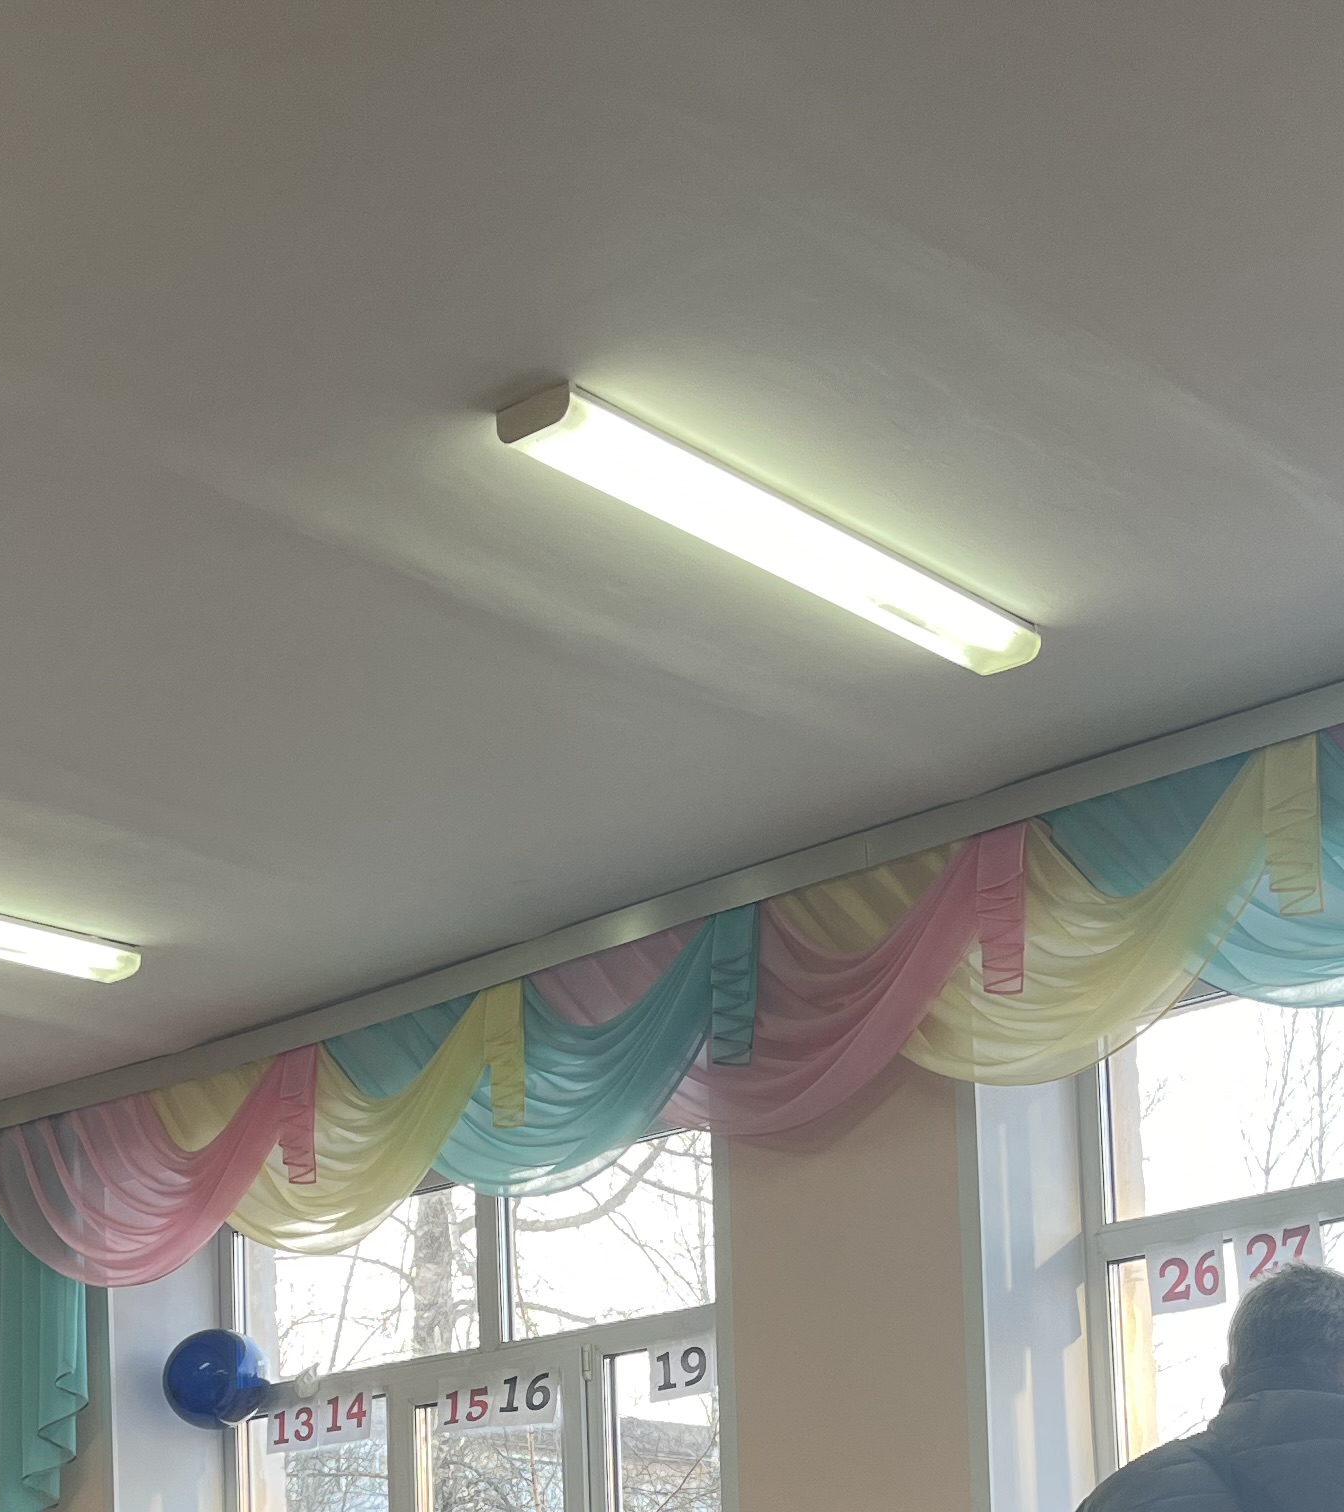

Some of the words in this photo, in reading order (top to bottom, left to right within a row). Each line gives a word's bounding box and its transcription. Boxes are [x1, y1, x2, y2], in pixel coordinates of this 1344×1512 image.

[1158, 1249, 1220, 1303] 26
[1246, 1224, 1312, 1281] 27
[656, 1346, 707, 1392] 19
[273, 1407, 314, 1445] 13
[326, 1391, 367, 1433] 14
[442, 1386, 490, 1426] 15
[499, 1372, 551, 1413] 16
